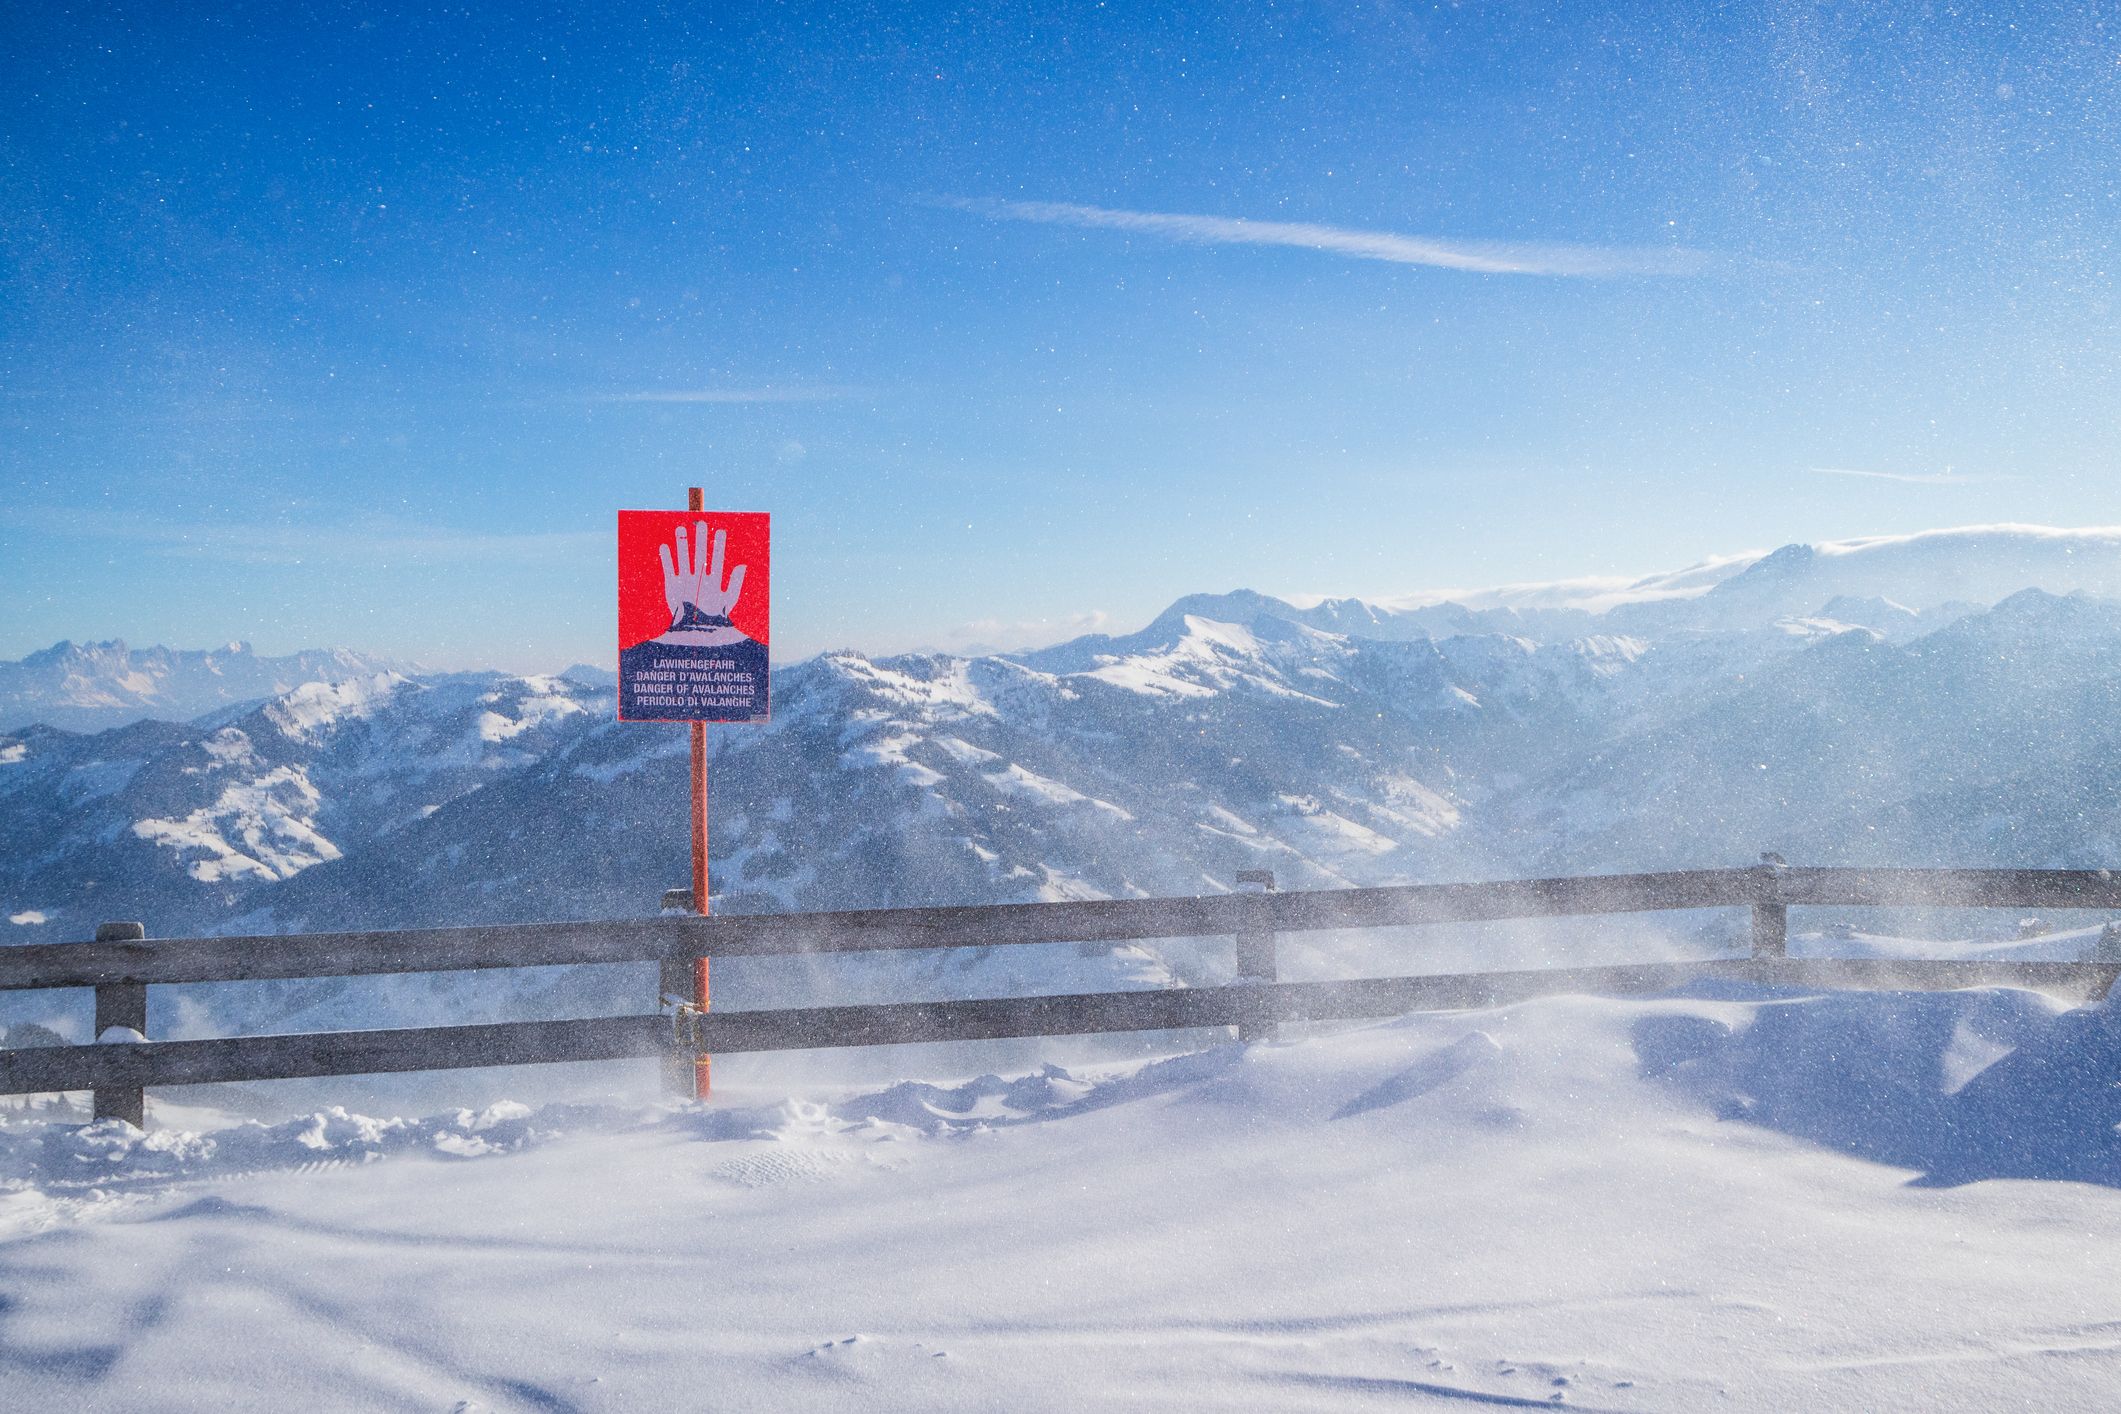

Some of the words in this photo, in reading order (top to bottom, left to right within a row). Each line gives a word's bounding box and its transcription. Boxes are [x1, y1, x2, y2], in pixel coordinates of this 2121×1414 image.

[653, 658, 735, 670] LAWINENGEFAHR
[636, 671, 676, 681] DANGER
[680, 672, 752, 682] D'AVALANCHES
[633, 683, 673, 694] DANGER
[676, 684, 689, 694] OF
[691, 684, 755, 695] AVALANCHES
[636, 696, 685, 706] PERICOLO
[688, 696, 698, 707] DI
[701, 697, 752, 707] VALANGHE
